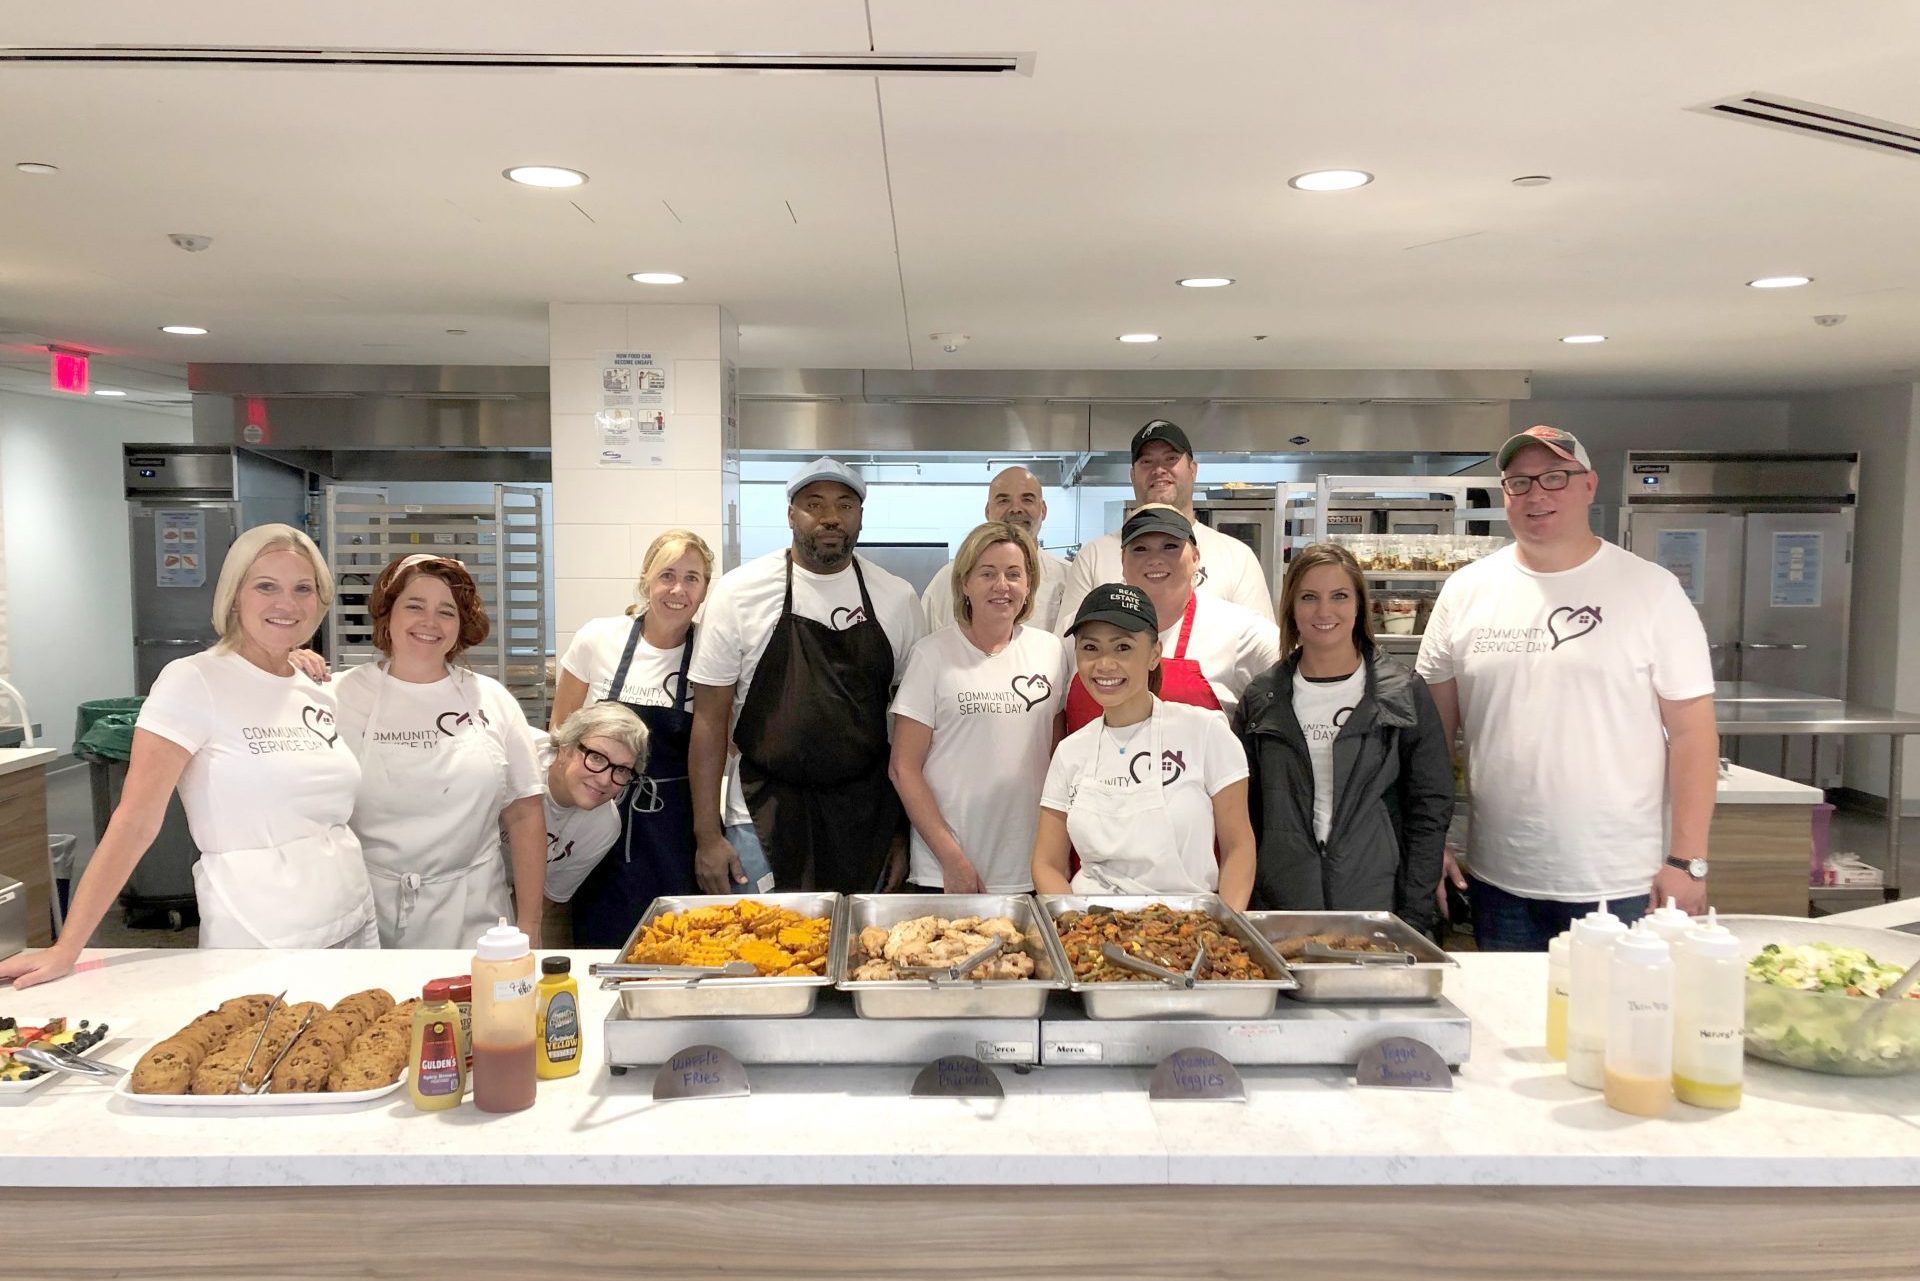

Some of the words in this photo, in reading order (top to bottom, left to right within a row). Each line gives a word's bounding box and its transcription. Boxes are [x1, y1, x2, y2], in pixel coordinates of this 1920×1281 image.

[1110, 594, 1140, 606] ESTATE
[1476, 627, 1546, 640] COMMUNITY
[1473, 641, 1522, 653] SERVICE
[1526, 641, 1549, 653] DAY
[957, 691, 1016, 703] COMMUNITY
[959, 702, 1003, 716] SERVICE
[1004, 703, 1023, 714] DAY
[242, 726, 312, 740] COMMUNITY
[1312, 729, 1336, 741] DAY
[248, 740, 304, 755] SERVICE
[547, 1038, 578, 1050] YELLOW
[994, 1045, 1016, 1053] erco
[1056, 1045, 1085, 1053] Merco
[421, 1057, 457, 1070] GULDEN'S
